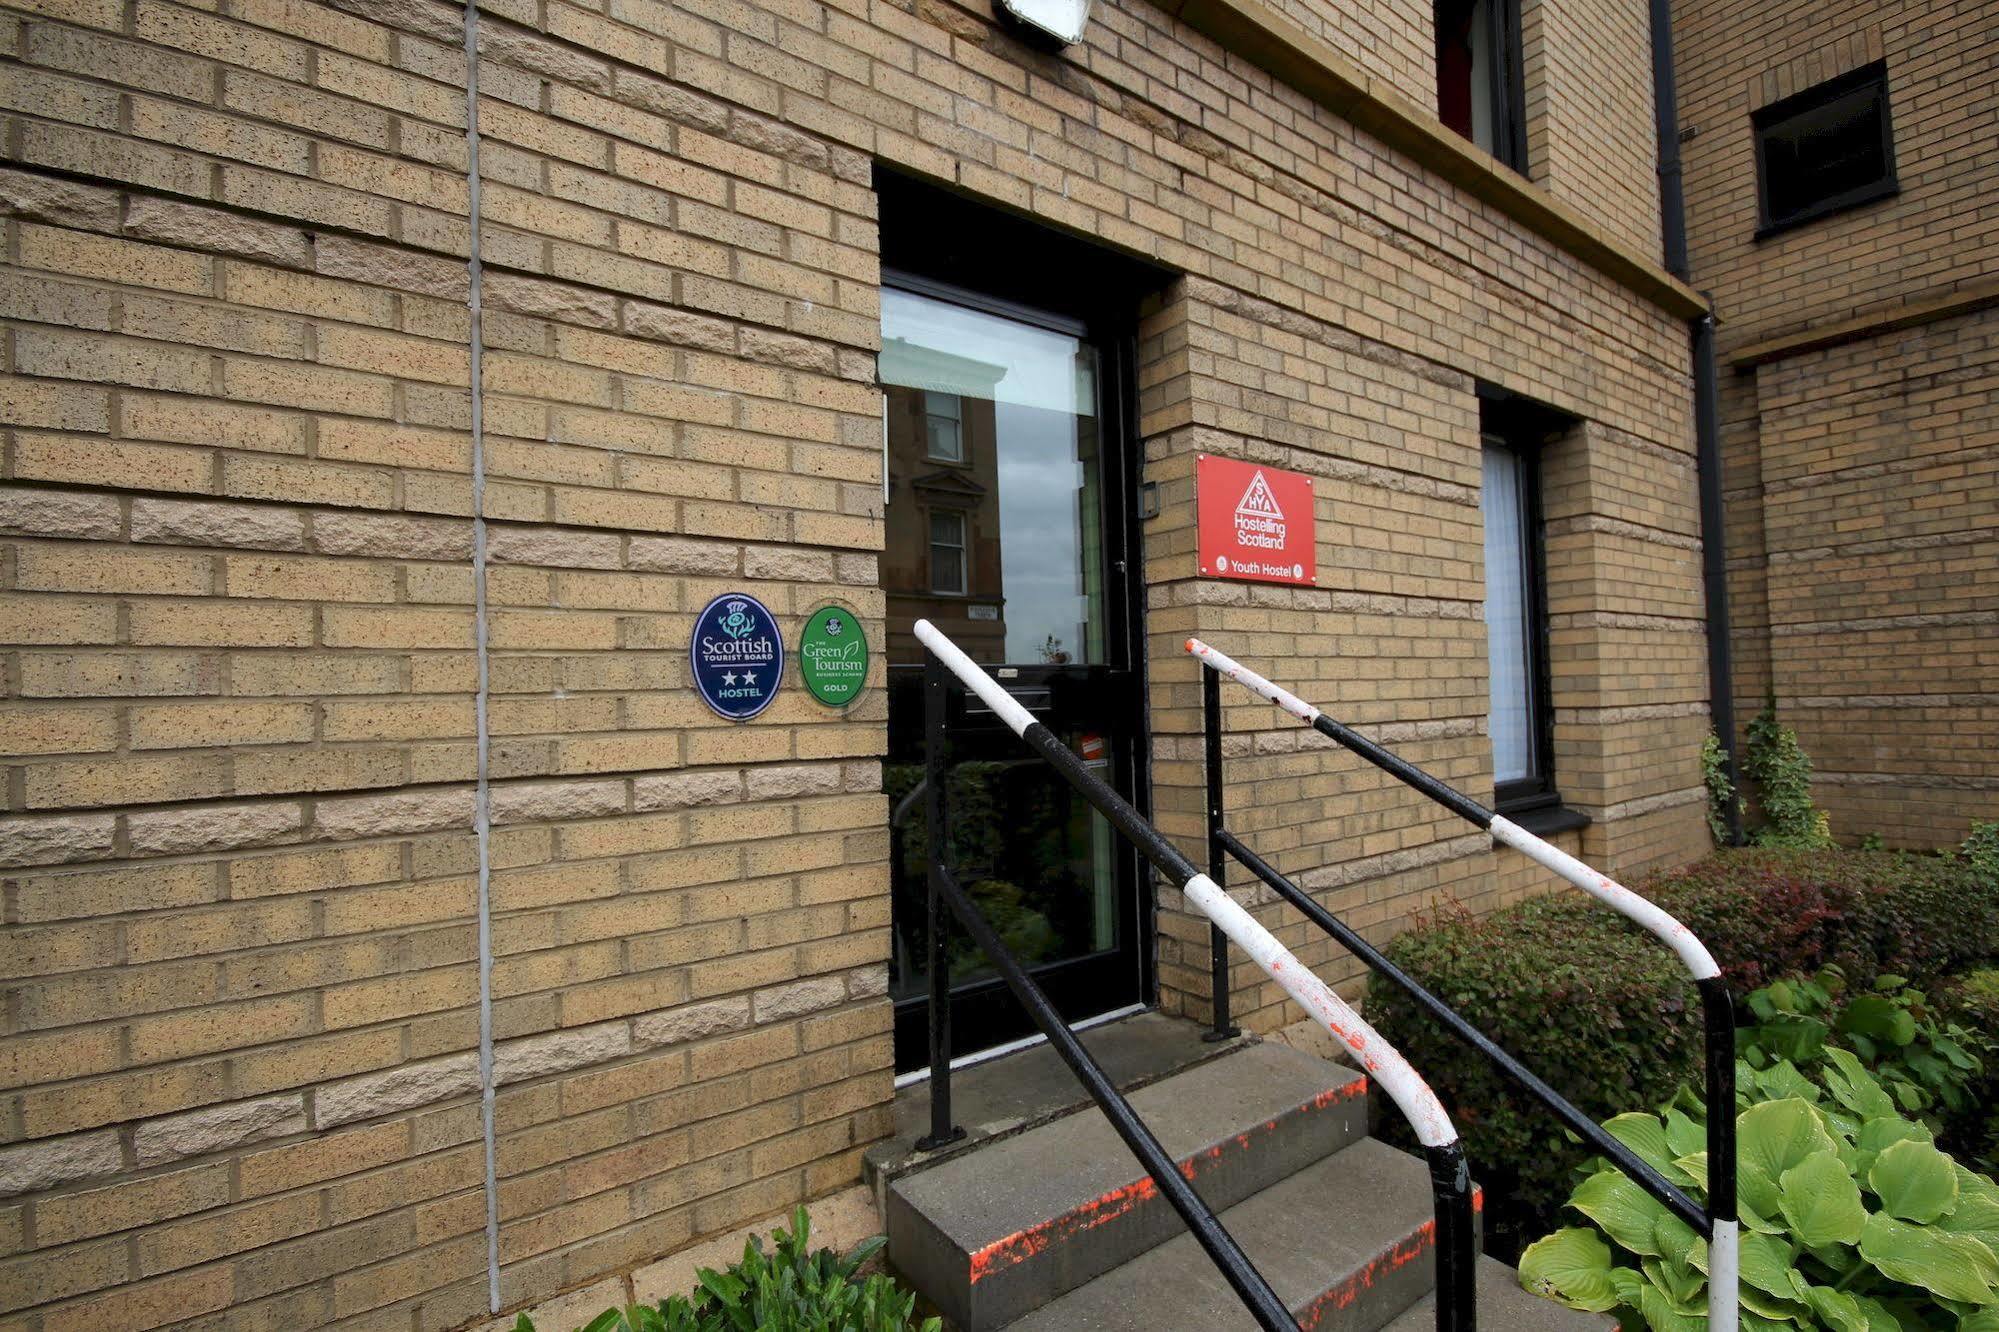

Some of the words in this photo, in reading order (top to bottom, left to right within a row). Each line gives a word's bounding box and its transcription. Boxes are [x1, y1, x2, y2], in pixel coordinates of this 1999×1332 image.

[1234, 514, 1286, 538] Hostelling
[1238, 530, 1285, 550] Scotland
[1231, 560, 1260, 574] Youth
[1262, 562, 1292, 577] Hostel
[702, 636, 773, 655] Scottish
[803, 643, 842, 657] Green
[812, 656, 863, 670] Tourism
[718, 688, 763, 698] HOSTEL
[823, 684, 848, 692] GOLD
